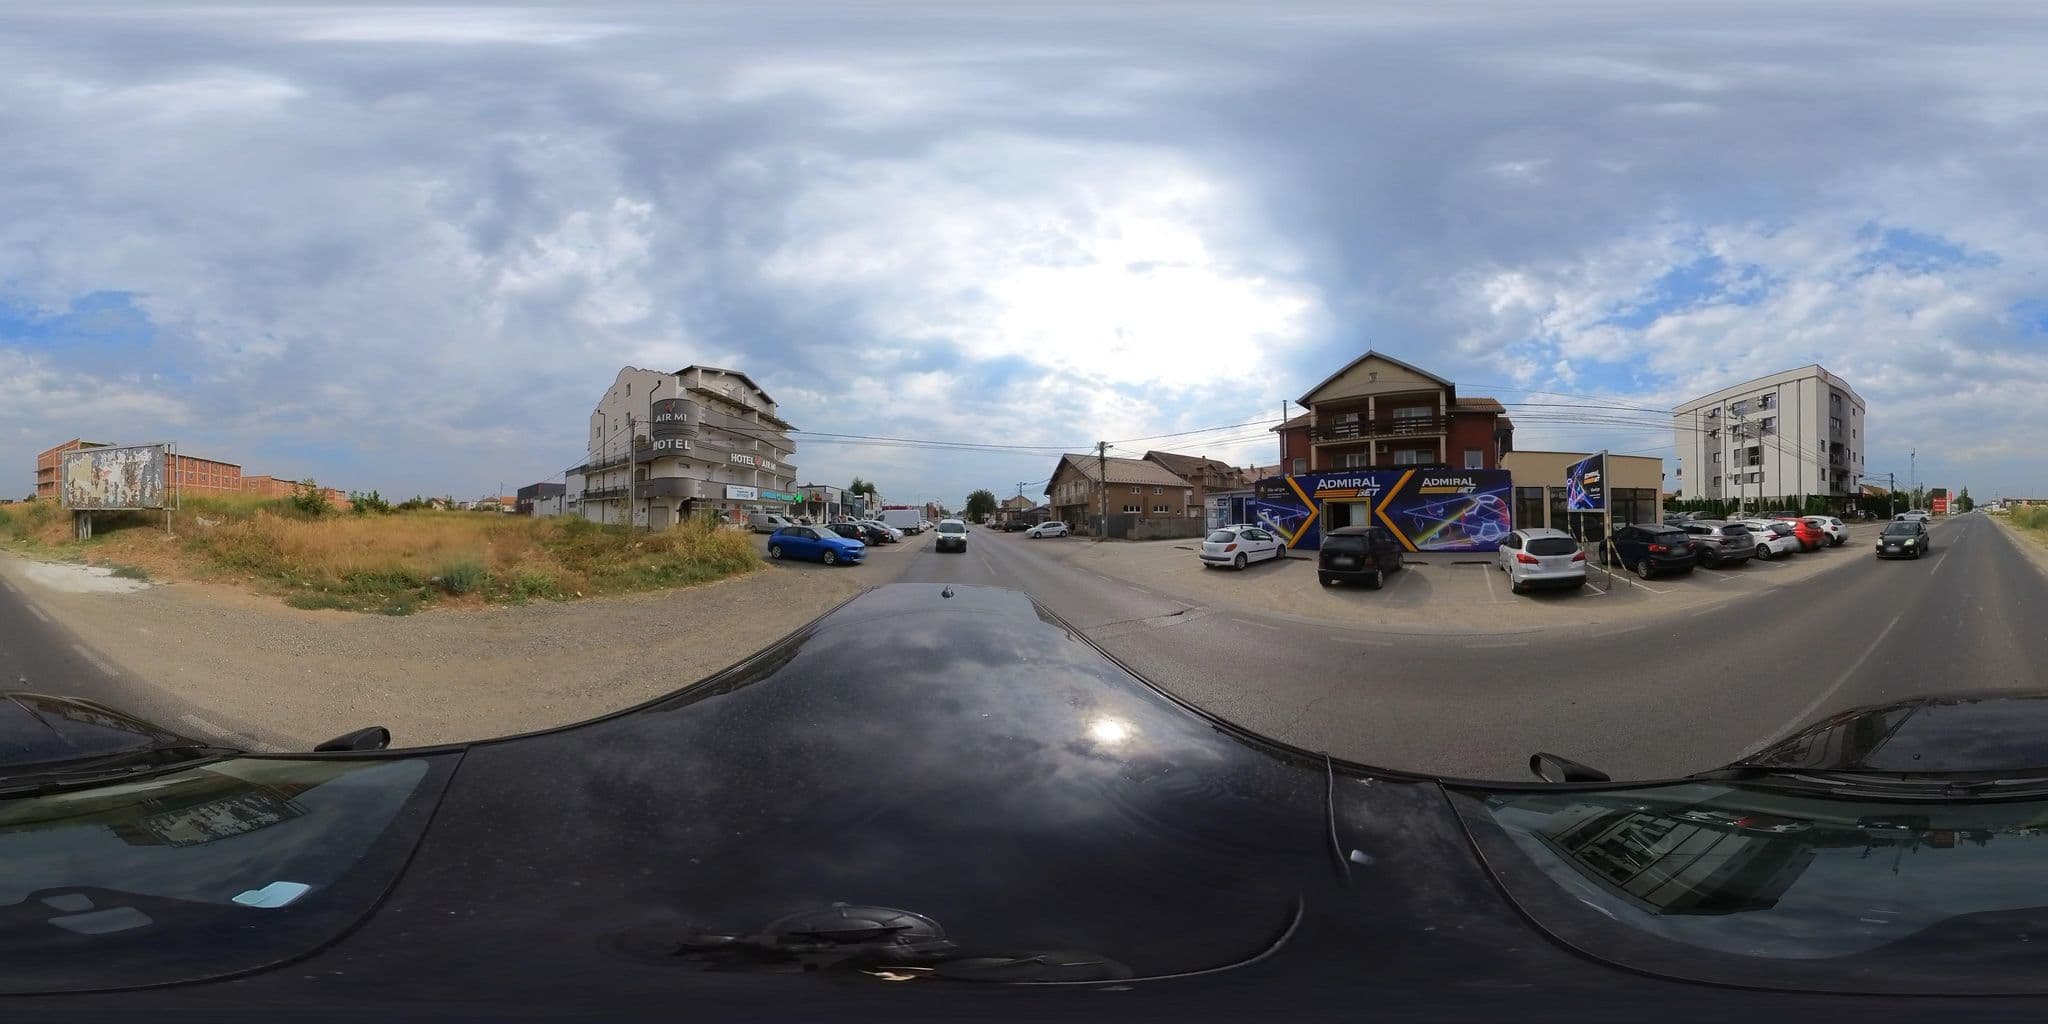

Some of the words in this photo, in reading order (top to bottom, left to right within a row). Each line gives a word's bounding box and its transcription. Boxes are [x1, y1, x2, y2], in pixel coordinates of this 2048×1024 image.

[655, 413, 672, 423] AIR
[674, 412, 687, 422] MI
[653, 439, 692, 451] HOTEL
[730, 452, 755, 466] HOTEL
[762, 459, 771, 470] AIR
[1316, 476, 1380, 490] ADMIRAL
[1421, 476, 1477, 487] ADMIRAL
[1357, 488, 1380, 497] BET
[1456, 486, 1477, 494] BET
